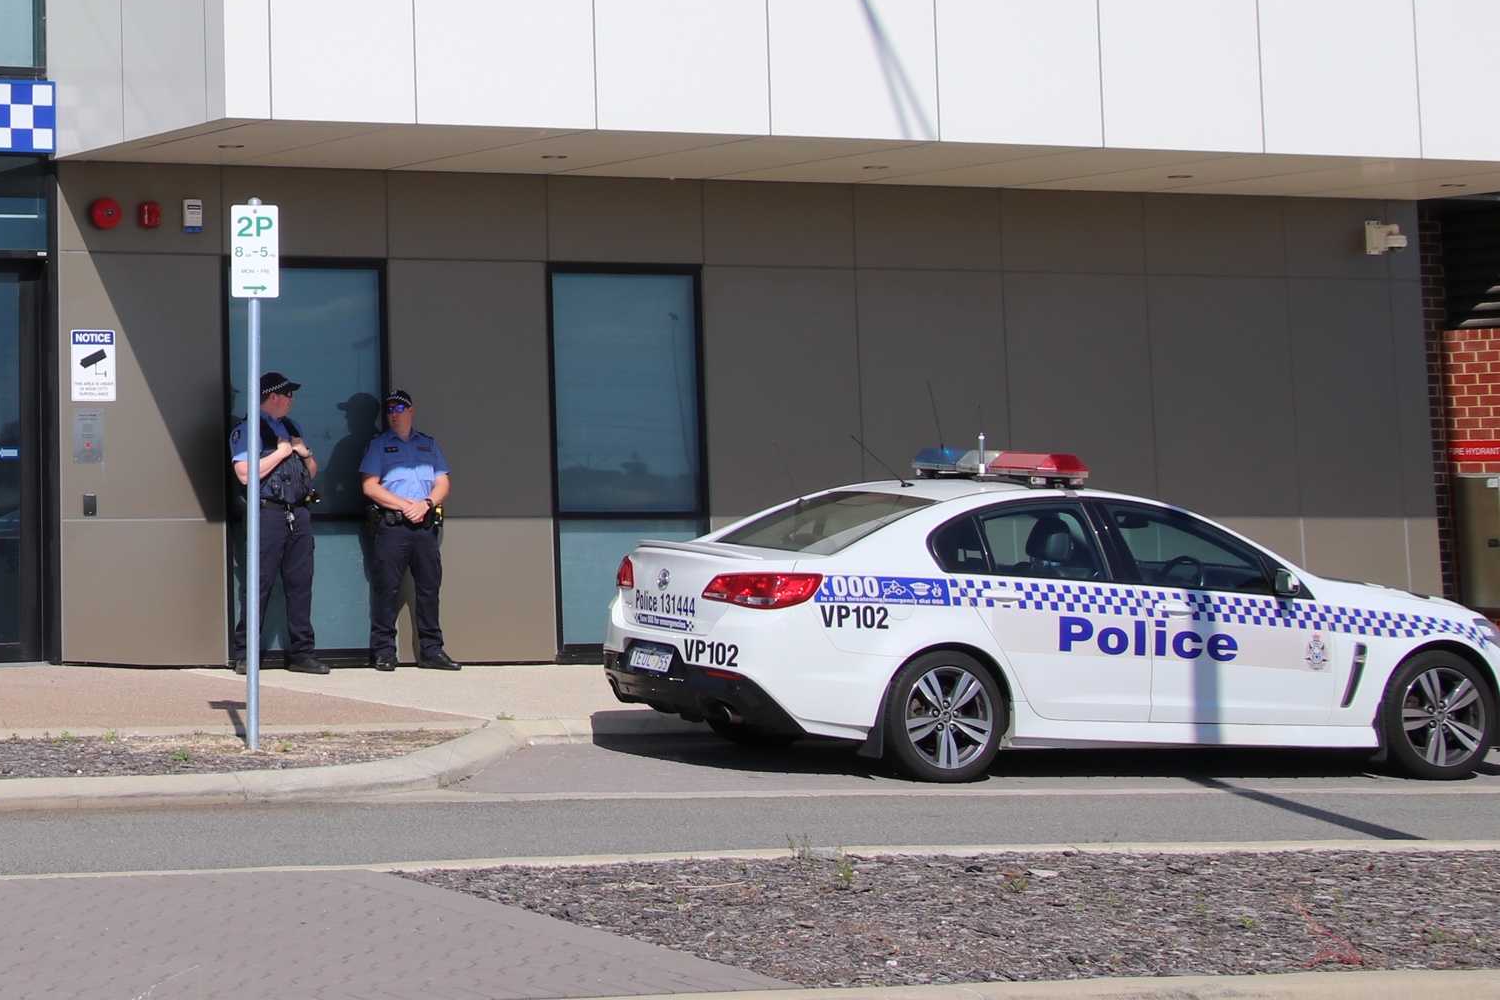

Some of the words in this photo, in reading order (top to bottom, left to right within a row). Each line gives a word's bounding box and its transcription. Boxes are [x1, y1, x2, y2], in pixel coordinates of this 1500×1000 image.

[237, 216, 273, 237] 2P
[75, 333, 112, 343] NOTICE
[1465, 447, 1500, 456] HYDRANT
[832, 575, 880, 598] 000
[635, 590, 658, 612] Police
[660, 592, 696, 617] 131444
[820, 604, 889, 630] VP102
[1058, 615, 1239, 662] Police
[684, 638, 739, 668] VP102
